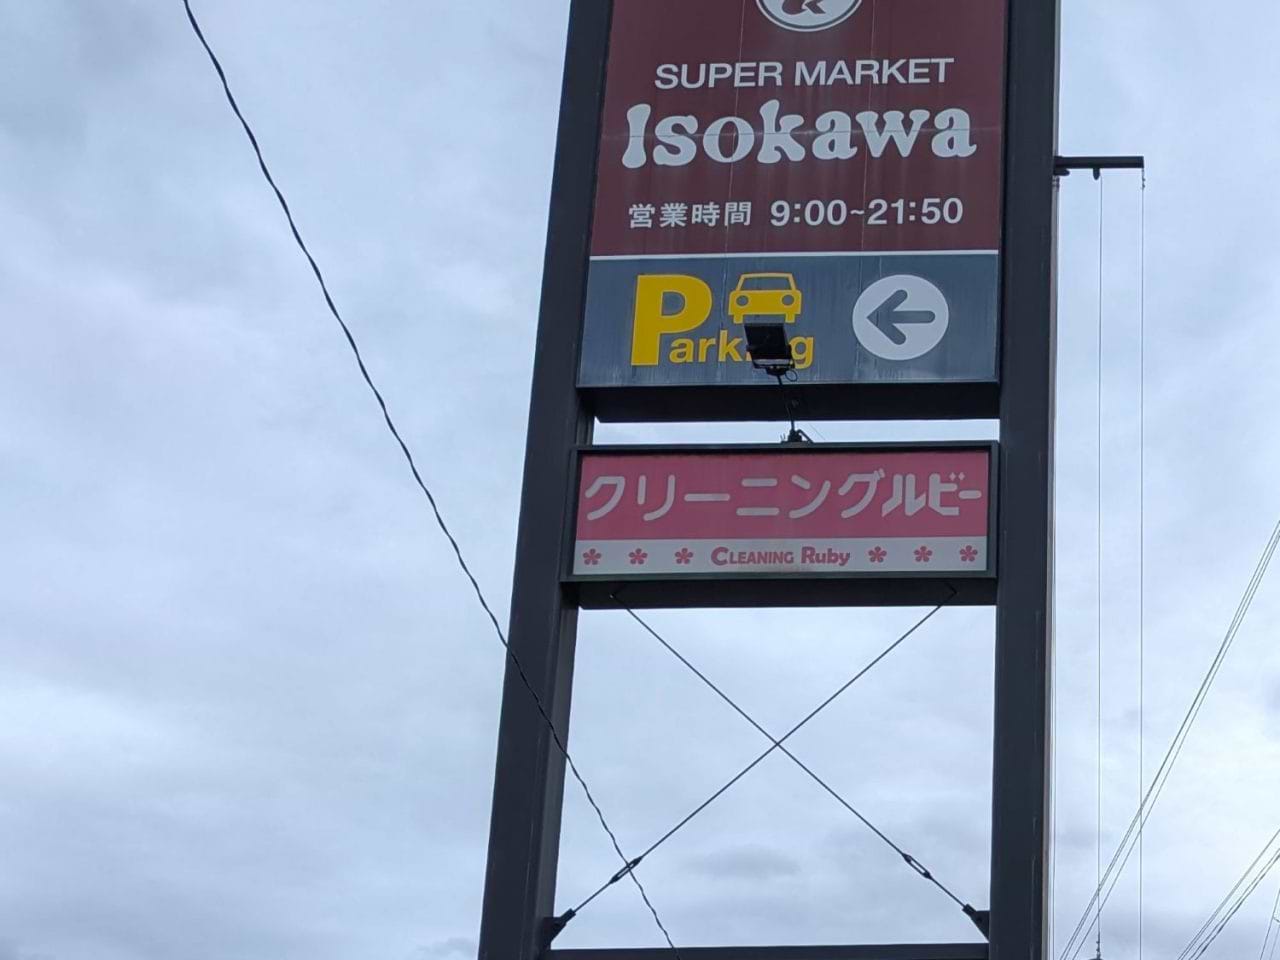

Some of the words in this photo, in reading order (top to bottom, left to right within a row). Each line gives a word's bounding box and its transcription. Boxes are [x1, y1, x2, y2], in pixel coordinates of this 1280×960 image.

[654, 61, 783, 90] SUPER
[794, 57, 955, 87] MARKET
[621, 98, 978, 169] Isokawa
[628, 201, 753, 229] 営業時間
[800, 546, 851, 568] Ruby
